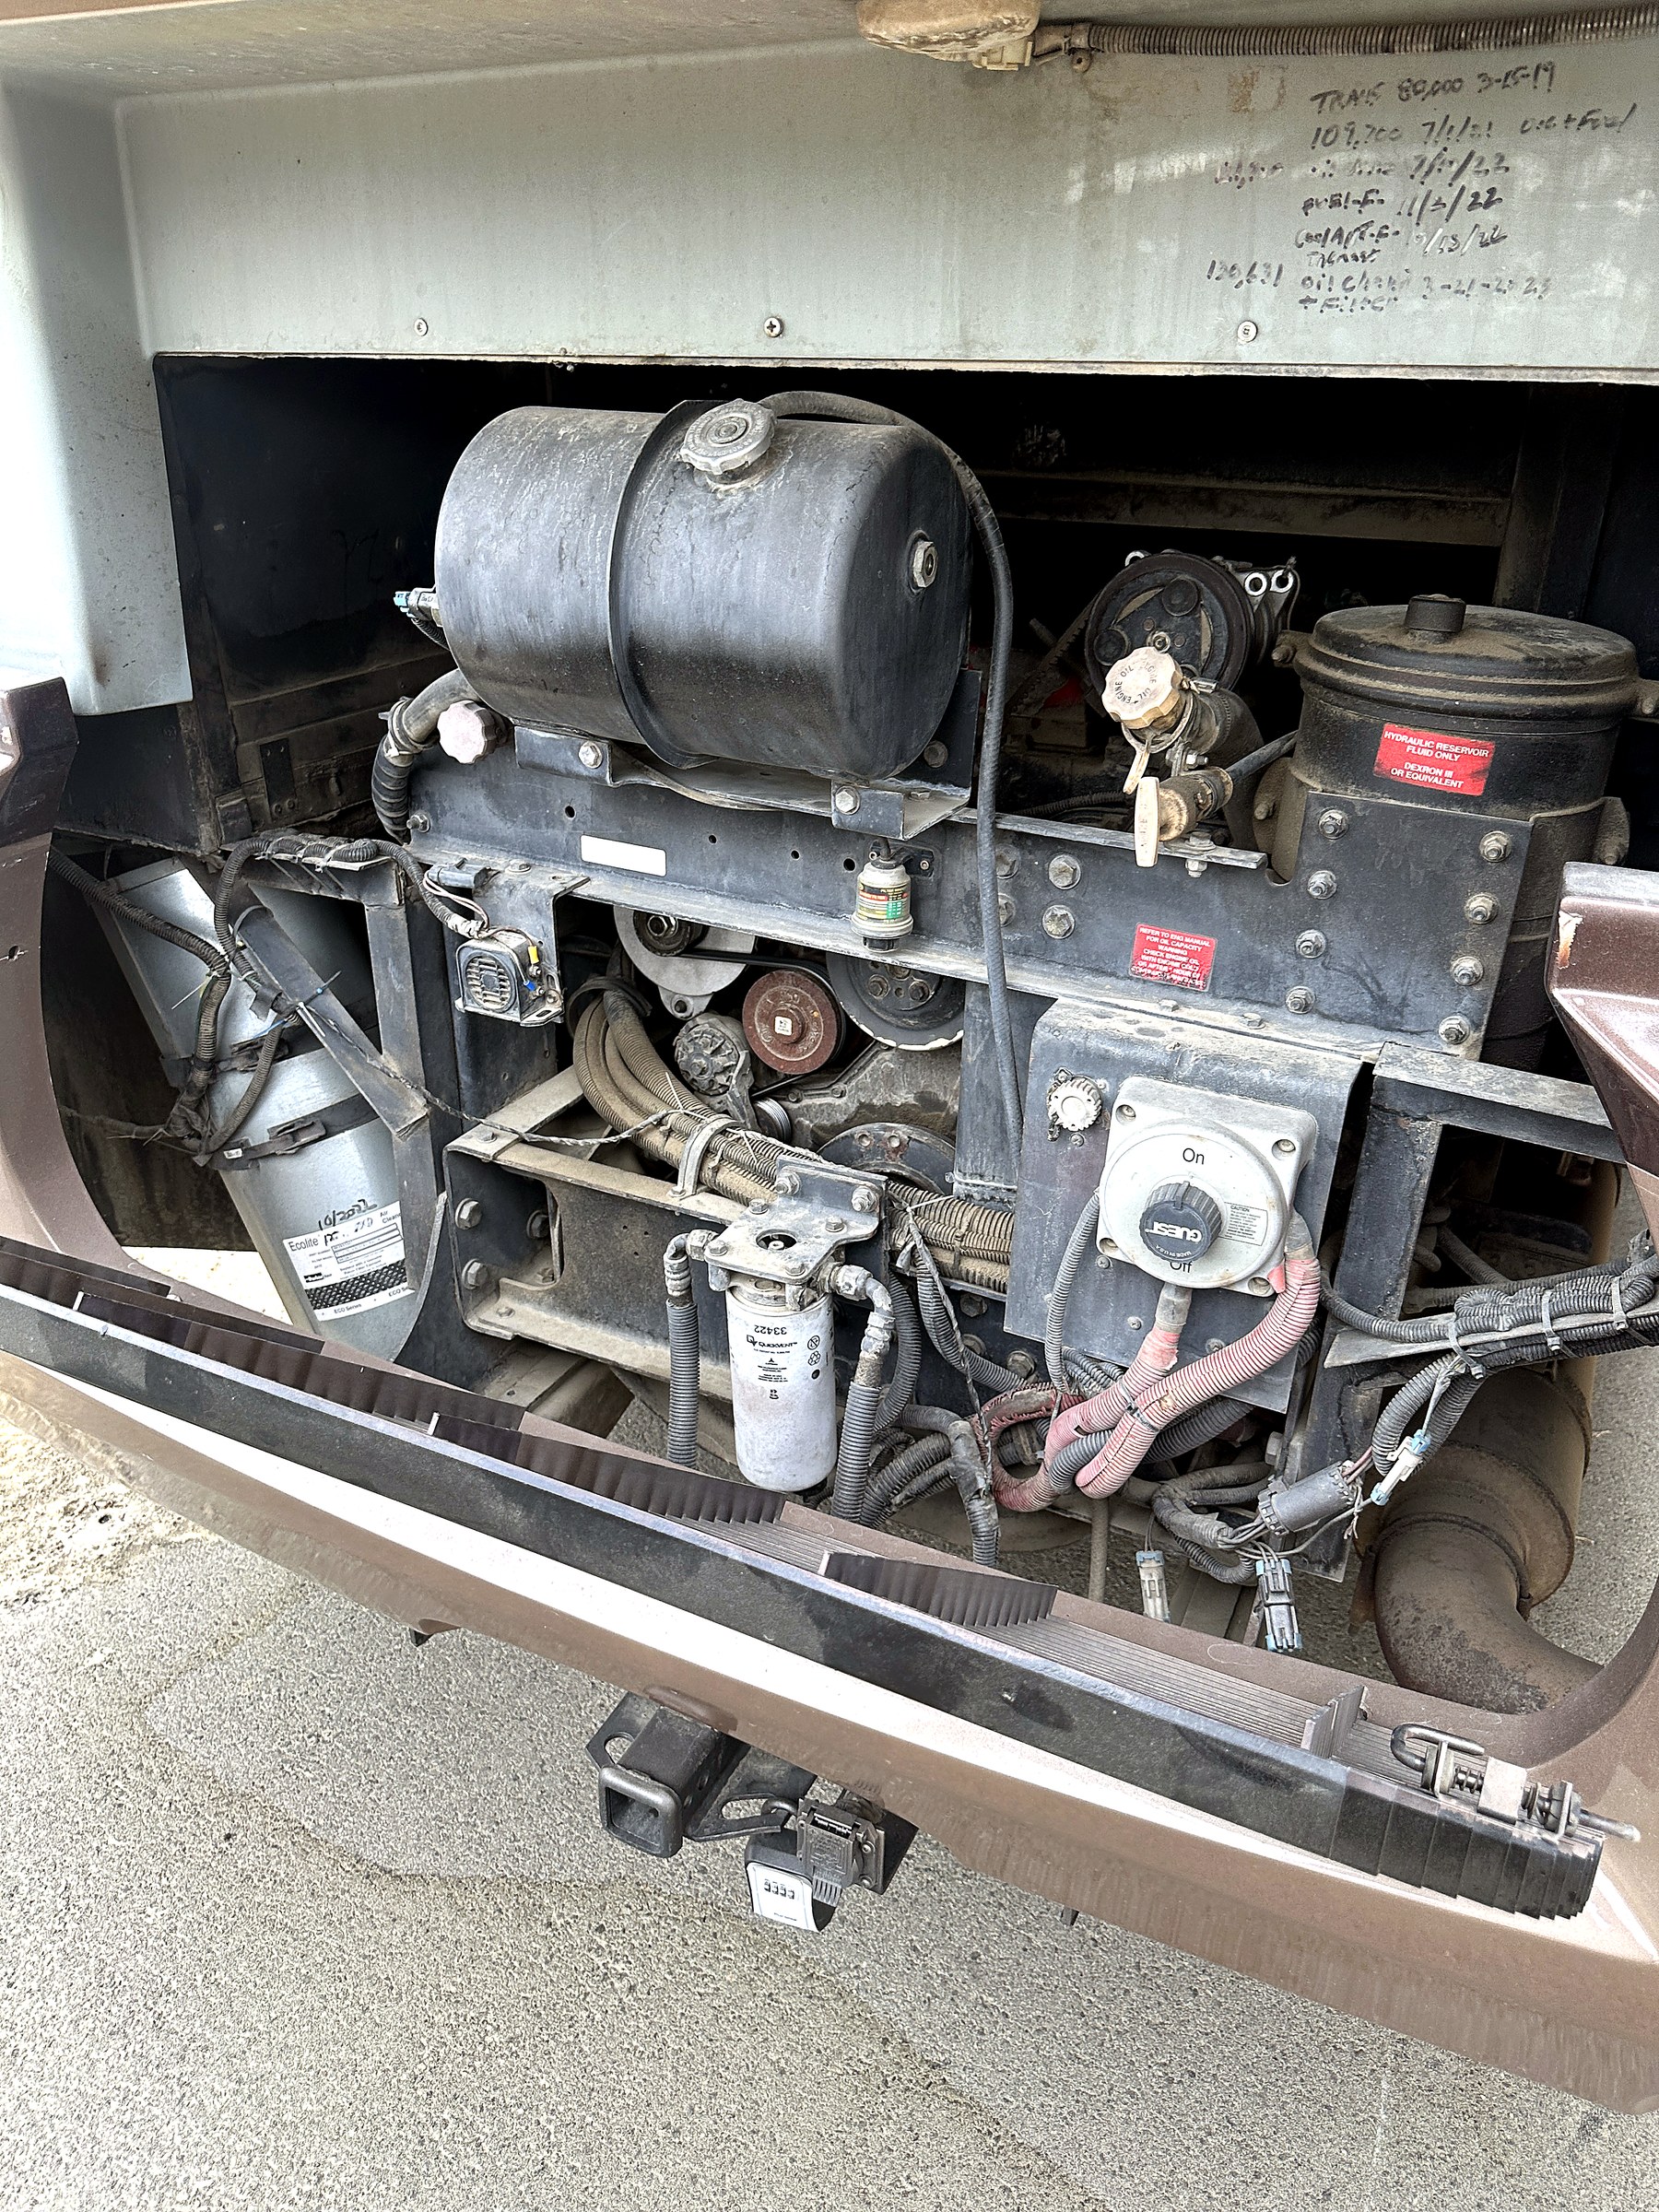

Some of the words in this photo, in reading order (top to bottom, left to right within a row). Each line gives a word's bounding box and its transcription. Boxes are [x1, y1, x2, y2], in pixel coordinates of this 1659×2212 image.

[1384, 731, 1435, 748] HYDRAULIC
[1436, 742, 1489, 758] RESERVOIR
[1406, 745, 1434, 758] FLUID
[1434, 751, 1461, 761] ONLY
[1404, 762, 1443, 777] DEXRON
[1391, 768, 1405, 777] OR
[1406, 771, 1464, 788] EQUIVALENT
[1140, 927, 1160, 936] REFER
[1184, 936, 1211, 947] MANUAL
[1171, 941, 1203, 951] CAPACITY
[1143, 948, 1165, 958] CHECK
[1165, 952, 1189, 962] ENGINE
[1182, 1147, 1205, 1165] On
[1152, 1221, 1203, 1242] GUEST
[288, 1238, 319, 1252] Ecolite
[754, 1324, 787, 1335] 33422
